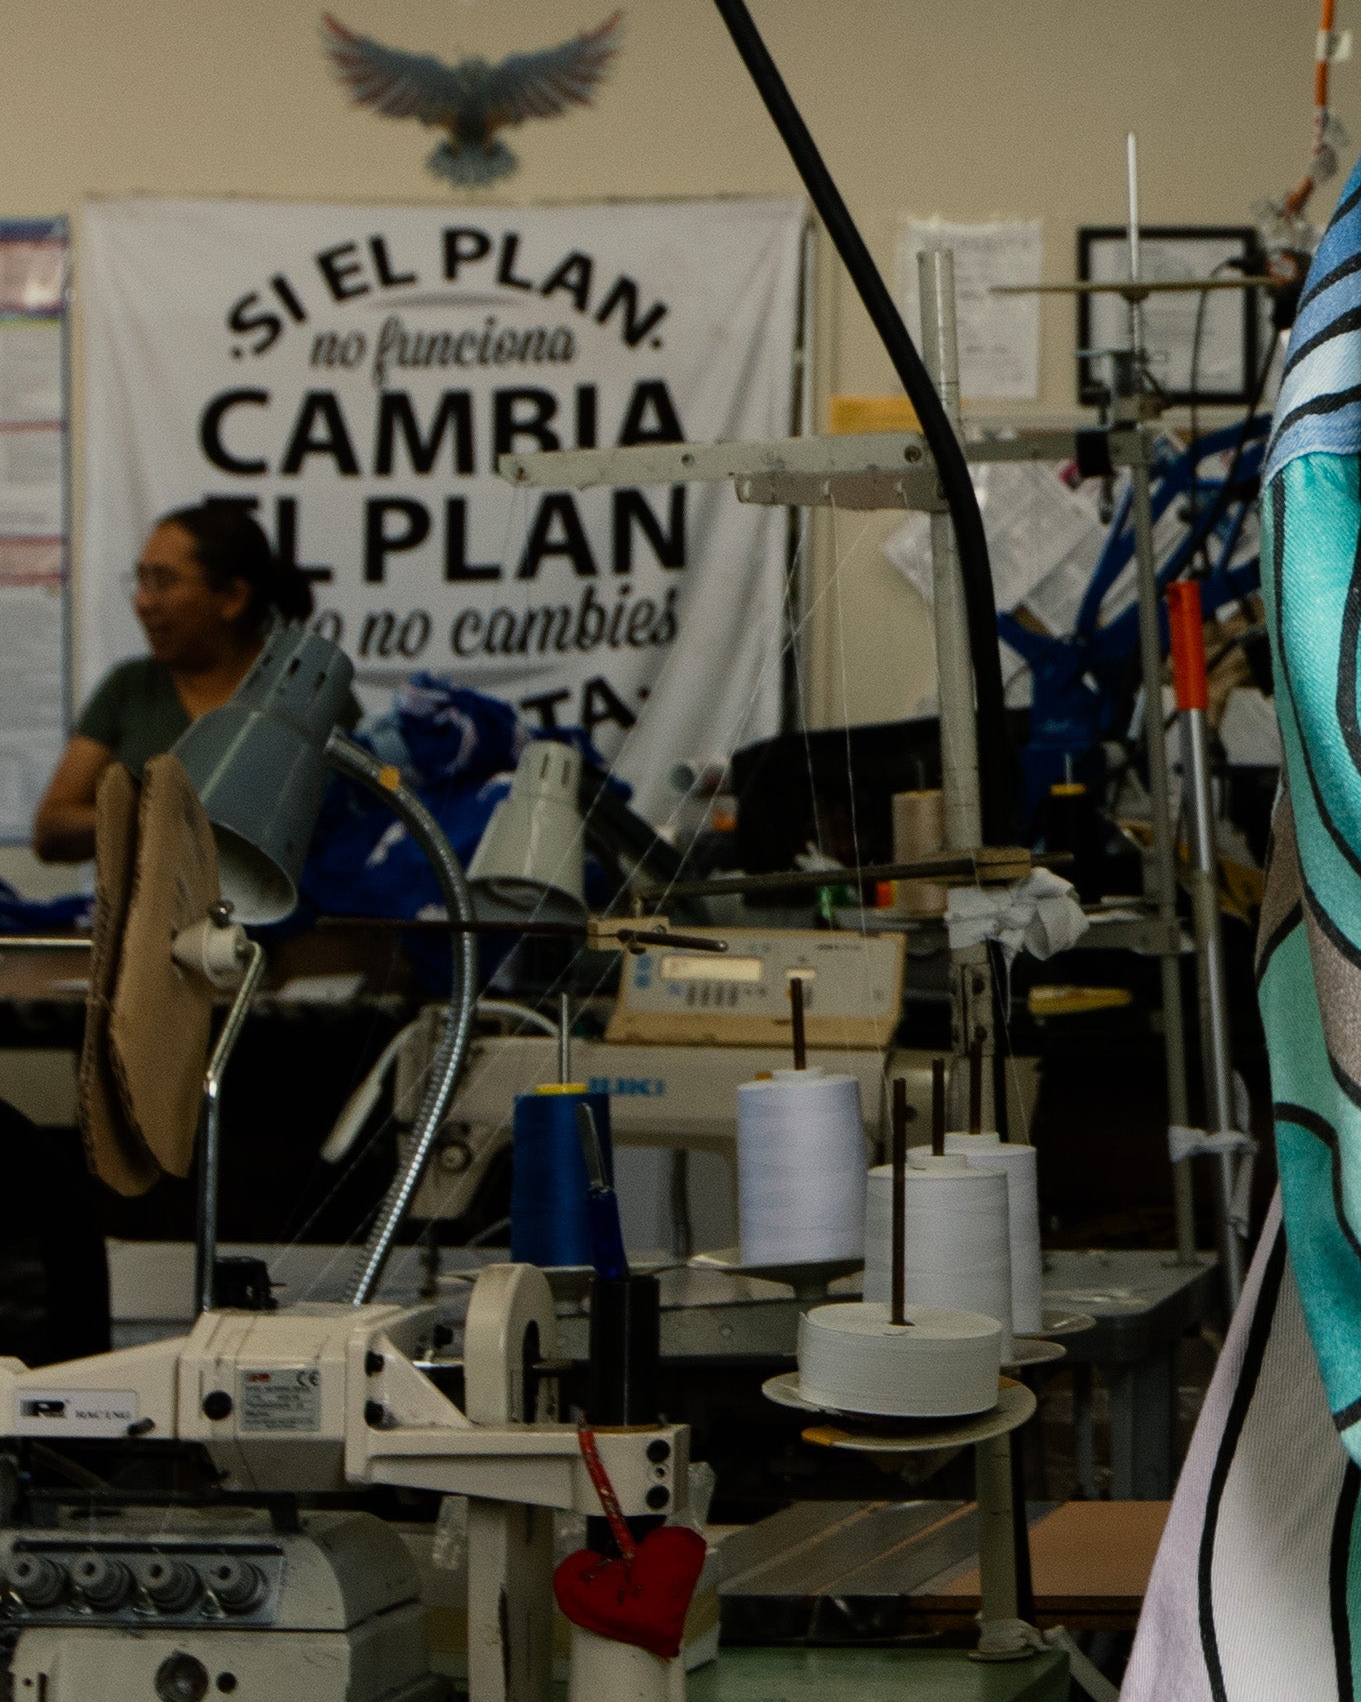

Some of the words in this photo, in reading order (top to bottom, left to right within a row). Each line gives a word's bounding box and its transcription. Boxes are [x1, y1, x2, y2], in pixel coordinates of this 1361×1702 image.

[315, 233, 416, 303] EL
[310, 327, 367, 371] no
[371, 315, 578, 387] funciona
[199, 377, 685, 478] CAMBIA
[363, 486, 687, 583] PLAN
[358, 609, 431, 659] no
[451, 585, 680, 659] cambies
